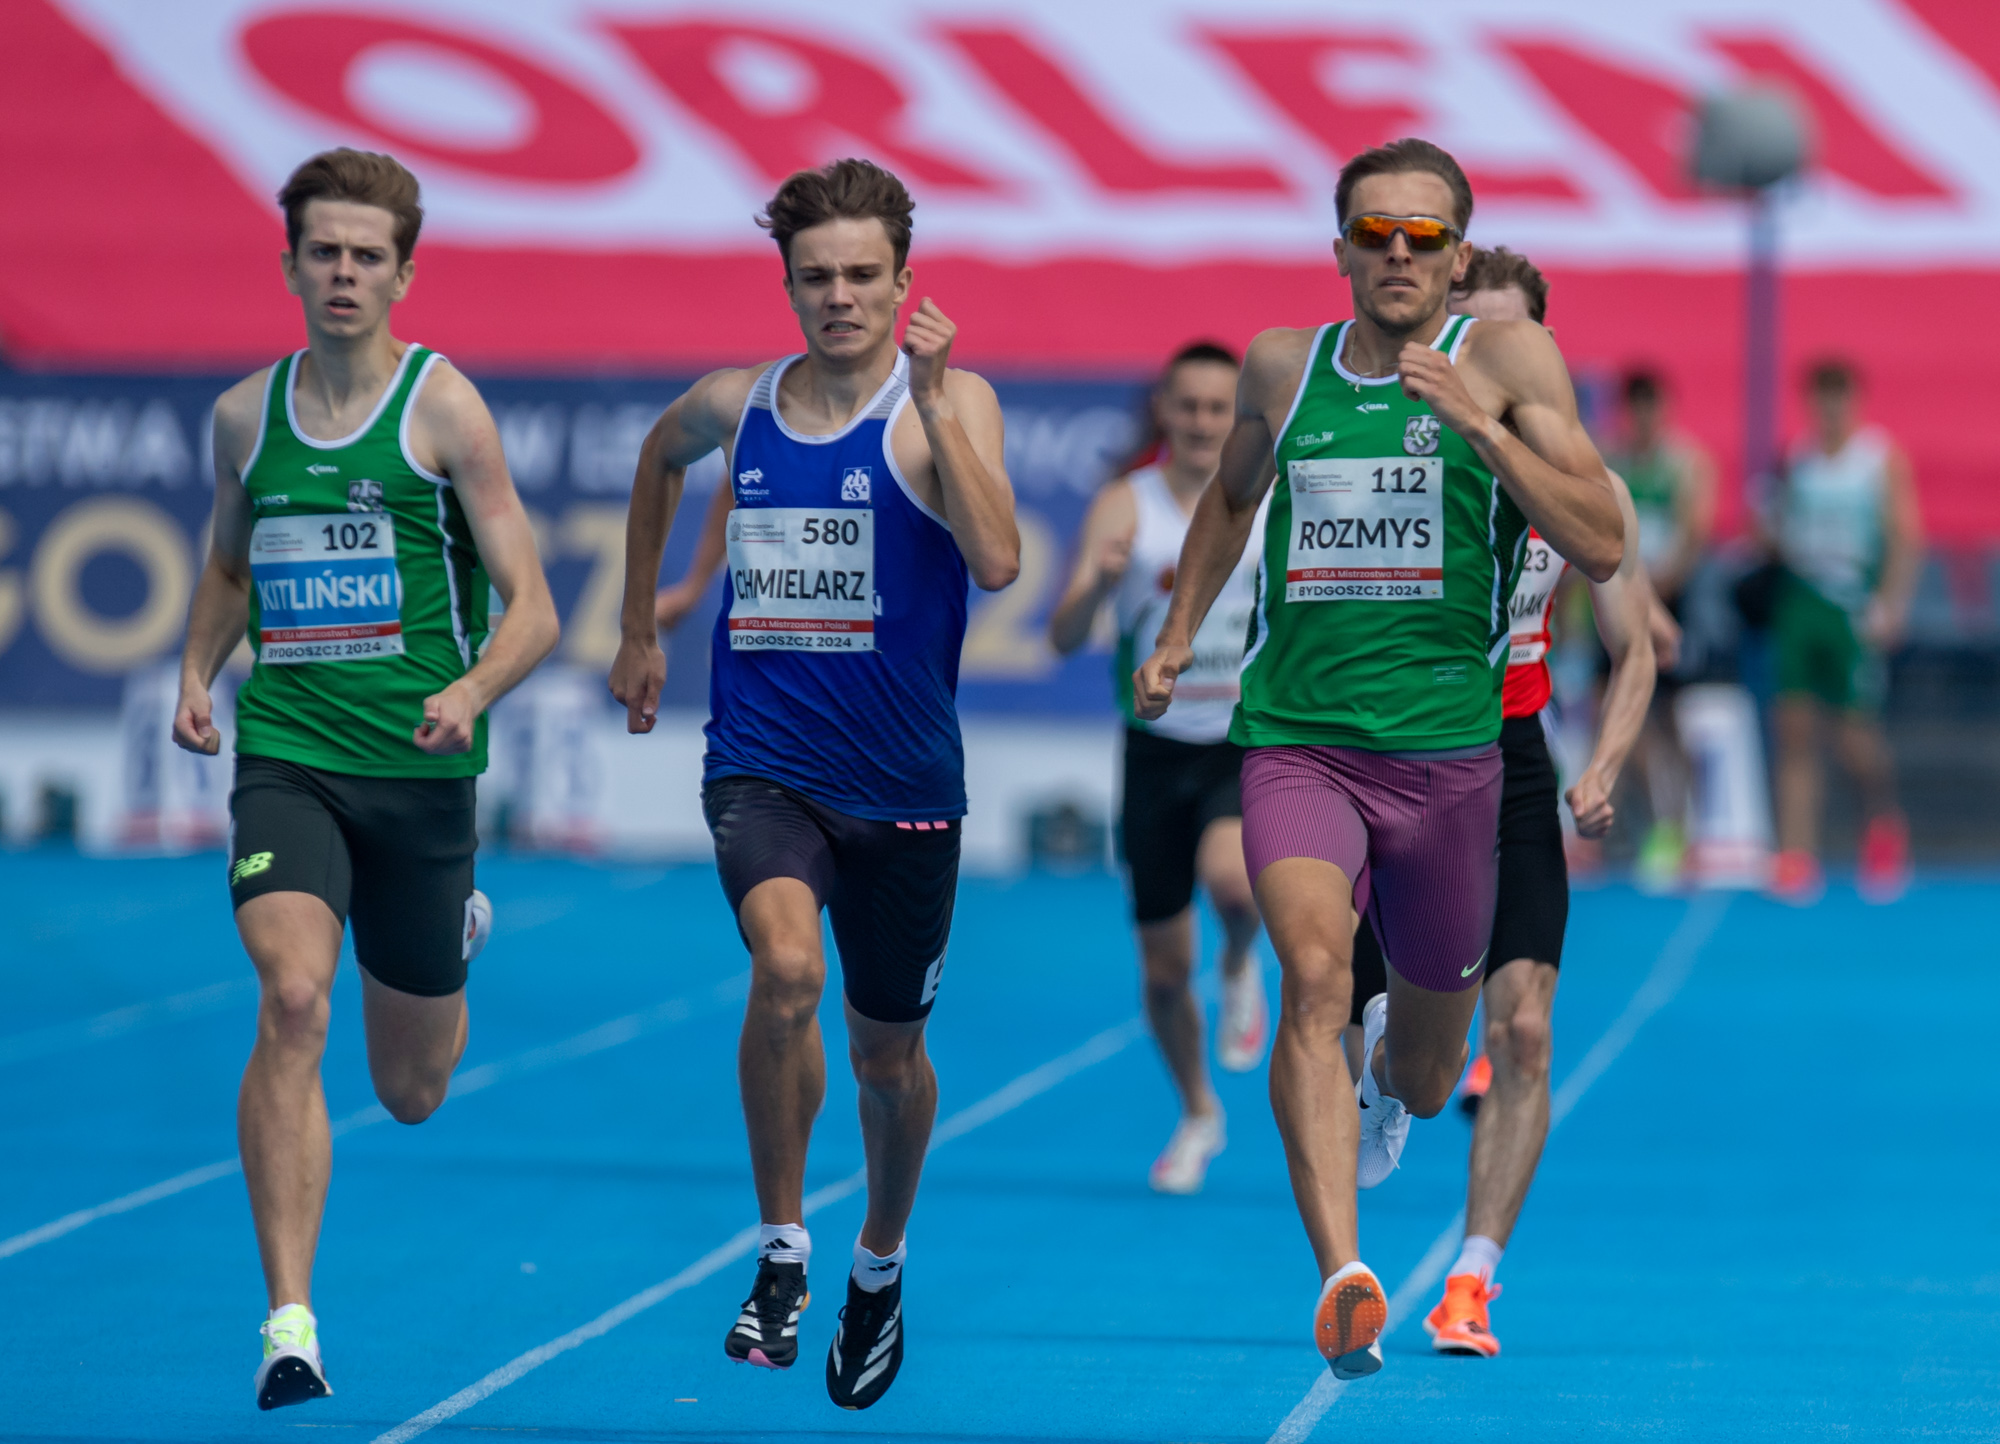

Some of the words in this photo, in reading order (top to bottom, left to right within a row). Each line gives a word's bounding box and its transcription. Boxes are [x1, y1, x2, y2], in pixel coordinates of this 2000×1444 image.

[235, 8, 1962, 208] ORLEN
[1371, 466, 1427, 493] 112
[322, 522, 378, 551] 102
[801, 518, 859, 545] 580
[1298, 518, 1431, 550] ROZMYS
[735, 568, 866, 601] CHMIELARZ
[1316, 570, 1336, 578] PZLA
[1338, 569, 1392, 578] Mistrzostwa
[1394, 569, 1420, 578] Polski
[257, 569, 391, 611] KITLIŃSKI
[1298, 585, 1383, 597] BYDGOSZCZ
[1386, 585, 1422, 596] 2024
[295, 629, 349, 639] Mistrzostwa
[350, 626, 378, 636] Polski
[748, 619, 767, 628] PZLA
[768, 620, 823, 630] Mistrzostwa
[824, 621, 851, 630] Polski
[268, 644, 341, 659] BYDGOSZCZ
[344, 642, 382, 655] 2024
[733, 635, 813, 647] BYDGOSZCZ
[816, 636, 852, 648] 2024
